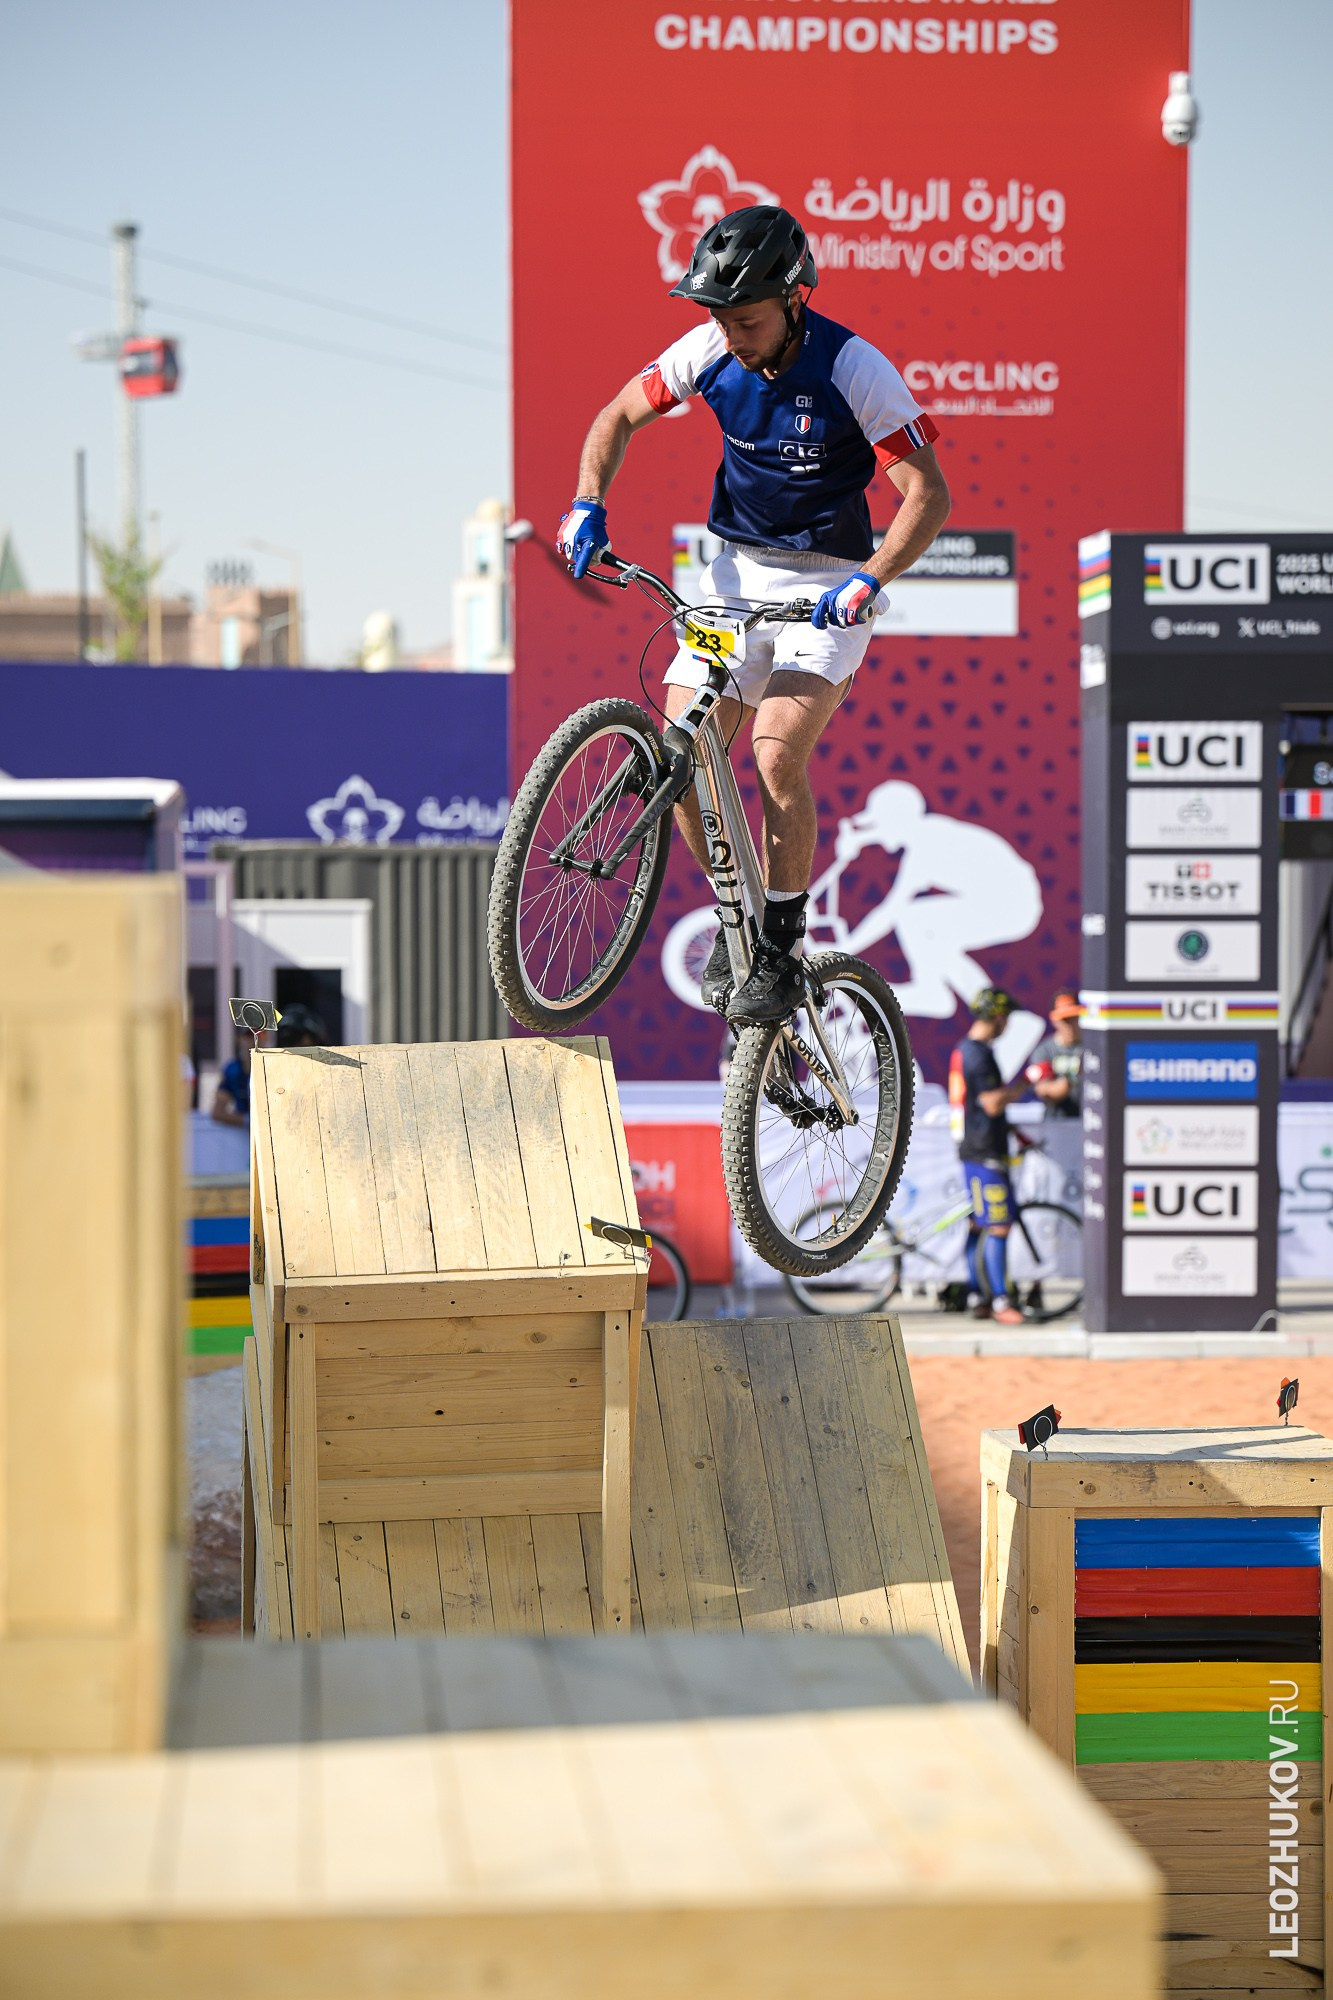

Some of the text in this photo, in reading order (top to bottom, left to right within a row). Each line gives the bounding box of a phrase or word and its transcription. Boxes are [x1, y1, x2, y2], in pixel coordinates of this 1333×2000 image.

[654, 14, 1059, 54] CHAMPIONSHIPS
[804, 177, 1066, 233] وزارة الرياضة
[808, 232, 926, 278] Ministry
[929, 234, 969, 272] of
[970, 234, 1066, 278] Sport
[903, 360, 1059, 391] CYCLING
[1169, 557, 1256, 591] UCI
[696, 629, 722, 652] 23
[1157, 735, 1243, 768] UCI
[1146, 882, 1240, 899] TISSOT
[1166, 1001, 1217, 1020] UCI
[790, 1028, 831, 1082] VORTEX
[1127, 1058, 1257, 1082] SHIMANO
[1153, 1185, 1239, 1216] UCI
